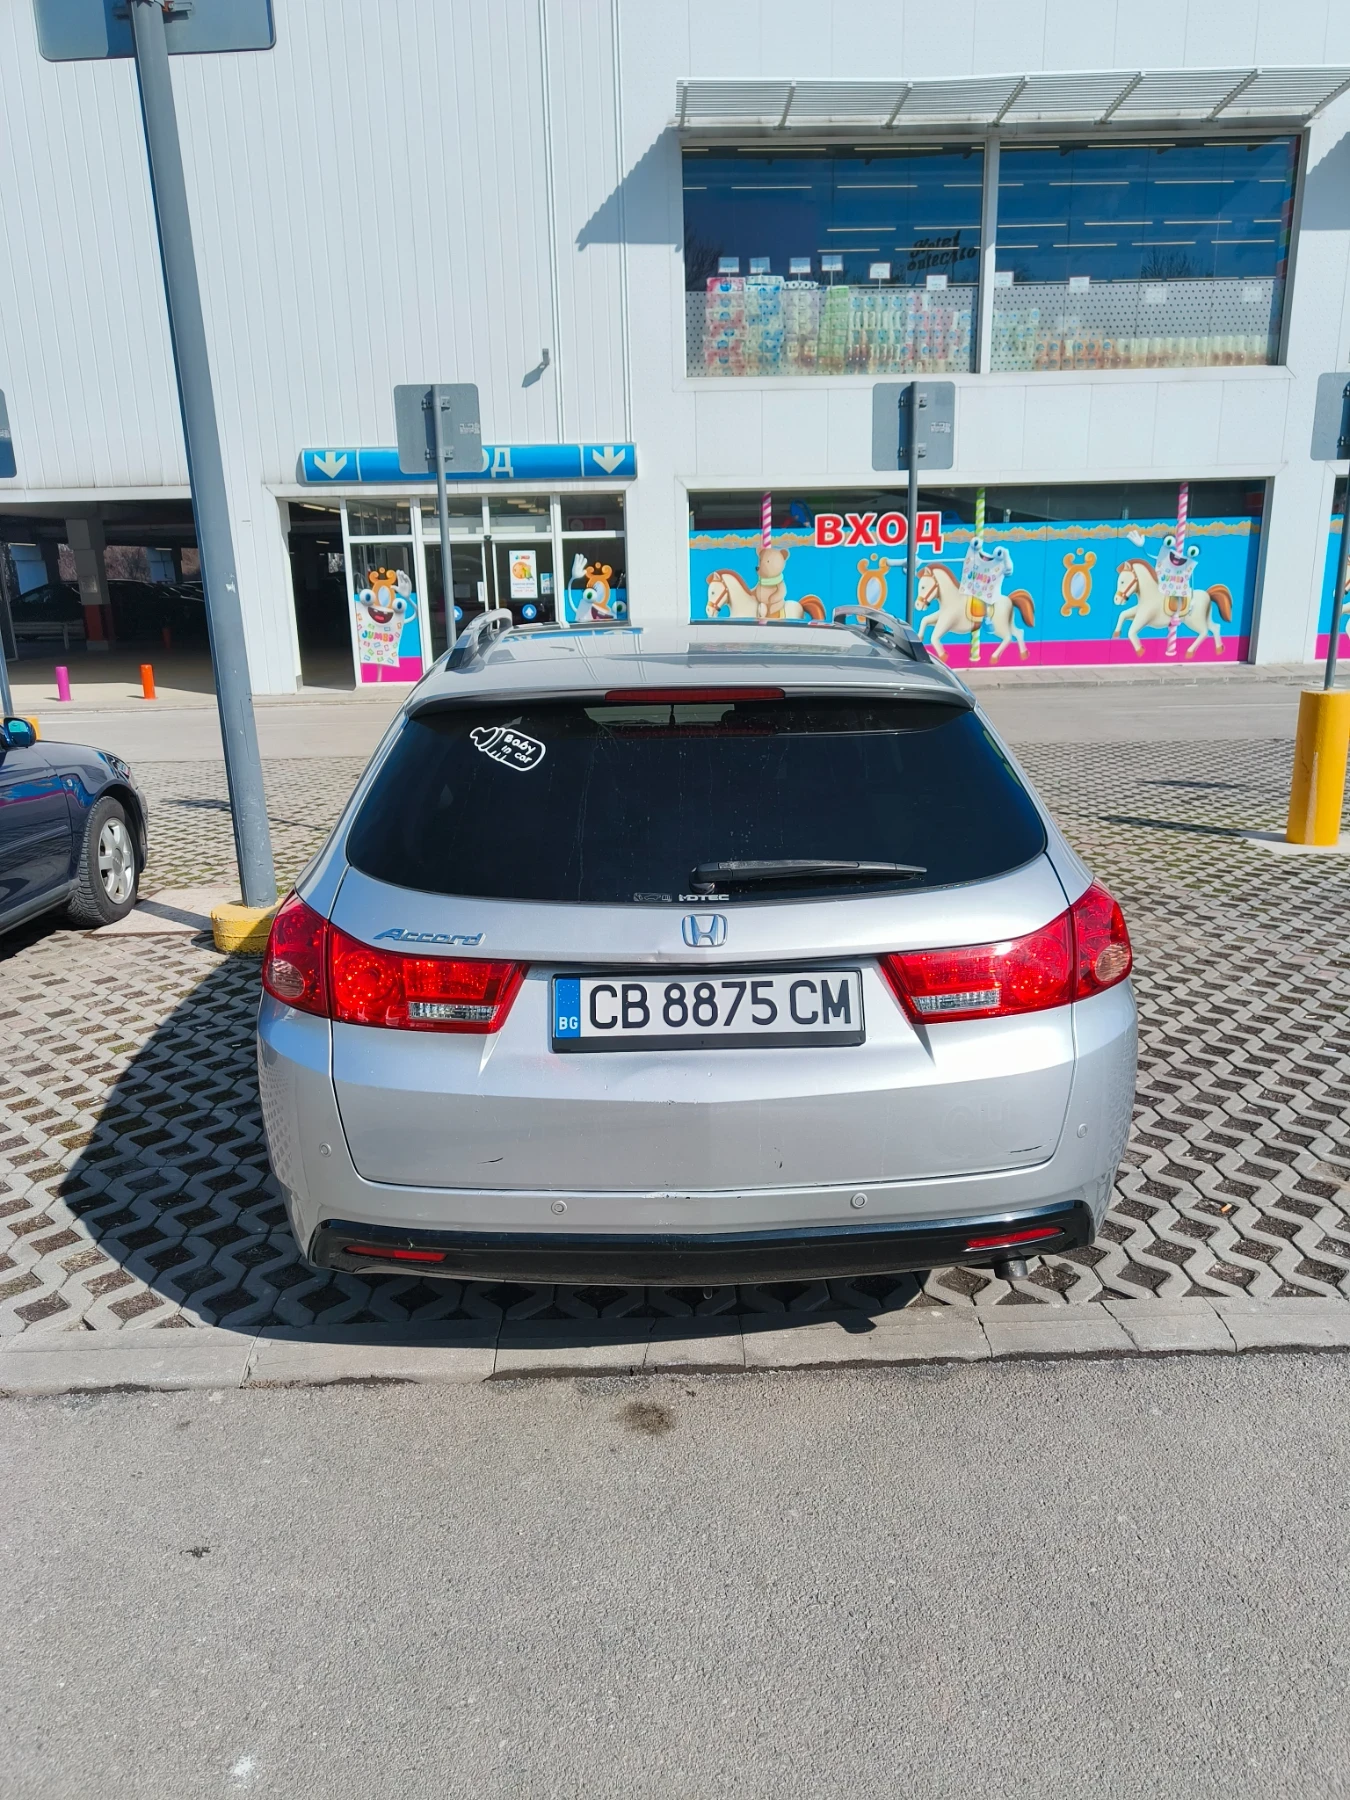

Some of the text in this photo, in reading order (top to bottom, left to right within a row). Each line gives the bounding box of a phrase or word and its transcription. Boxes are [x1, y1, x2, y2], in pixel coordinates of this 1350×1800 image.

[815, 511, 944, 554] ВХОД
[501, 745, 533, 763] in car
[504, 734, 536, 755] Baby
[373, 928, 486, 946] Accord
[558, 979, 851, 1030] BG CB 8875 CM
